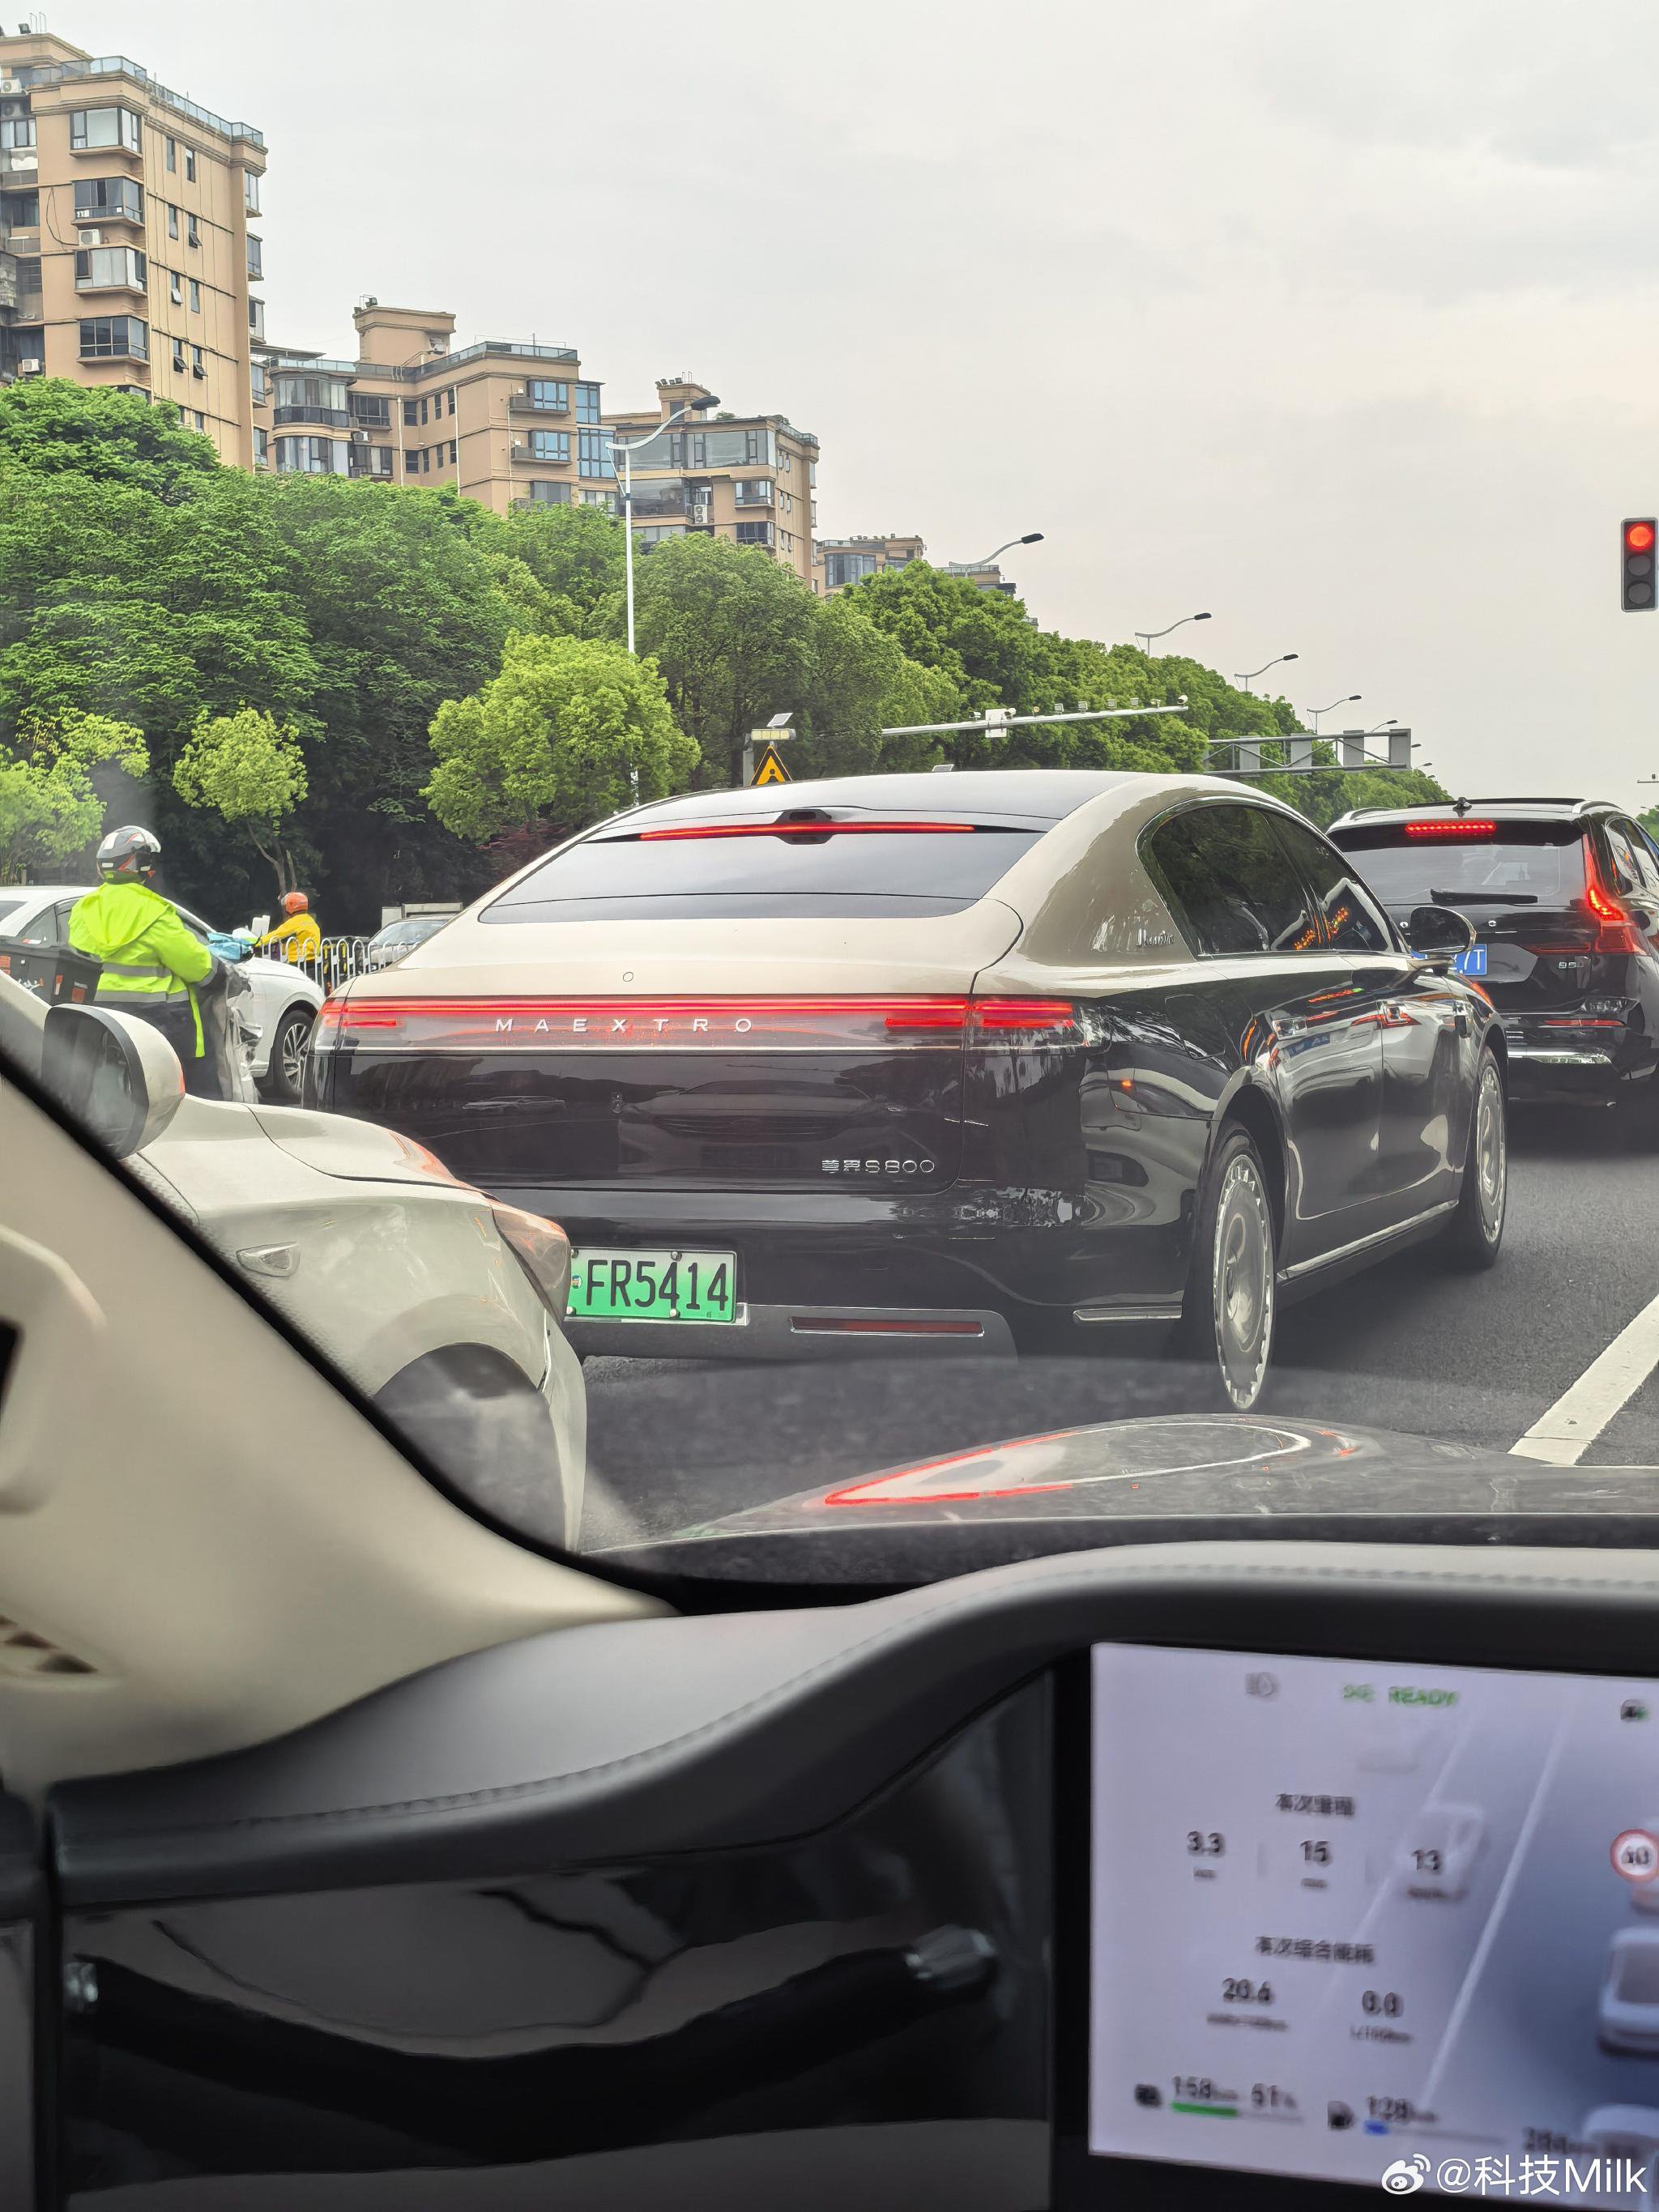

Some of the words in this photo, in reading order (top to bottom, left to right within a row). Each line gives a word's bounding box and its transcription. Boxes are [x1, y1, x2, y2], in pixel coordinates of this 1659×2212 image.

[494, 1018, 753, 1034] MAEXTRO
[585, 1259, 730, 1311] FR5414
[1299, 1839, 1332, 1865] 15
